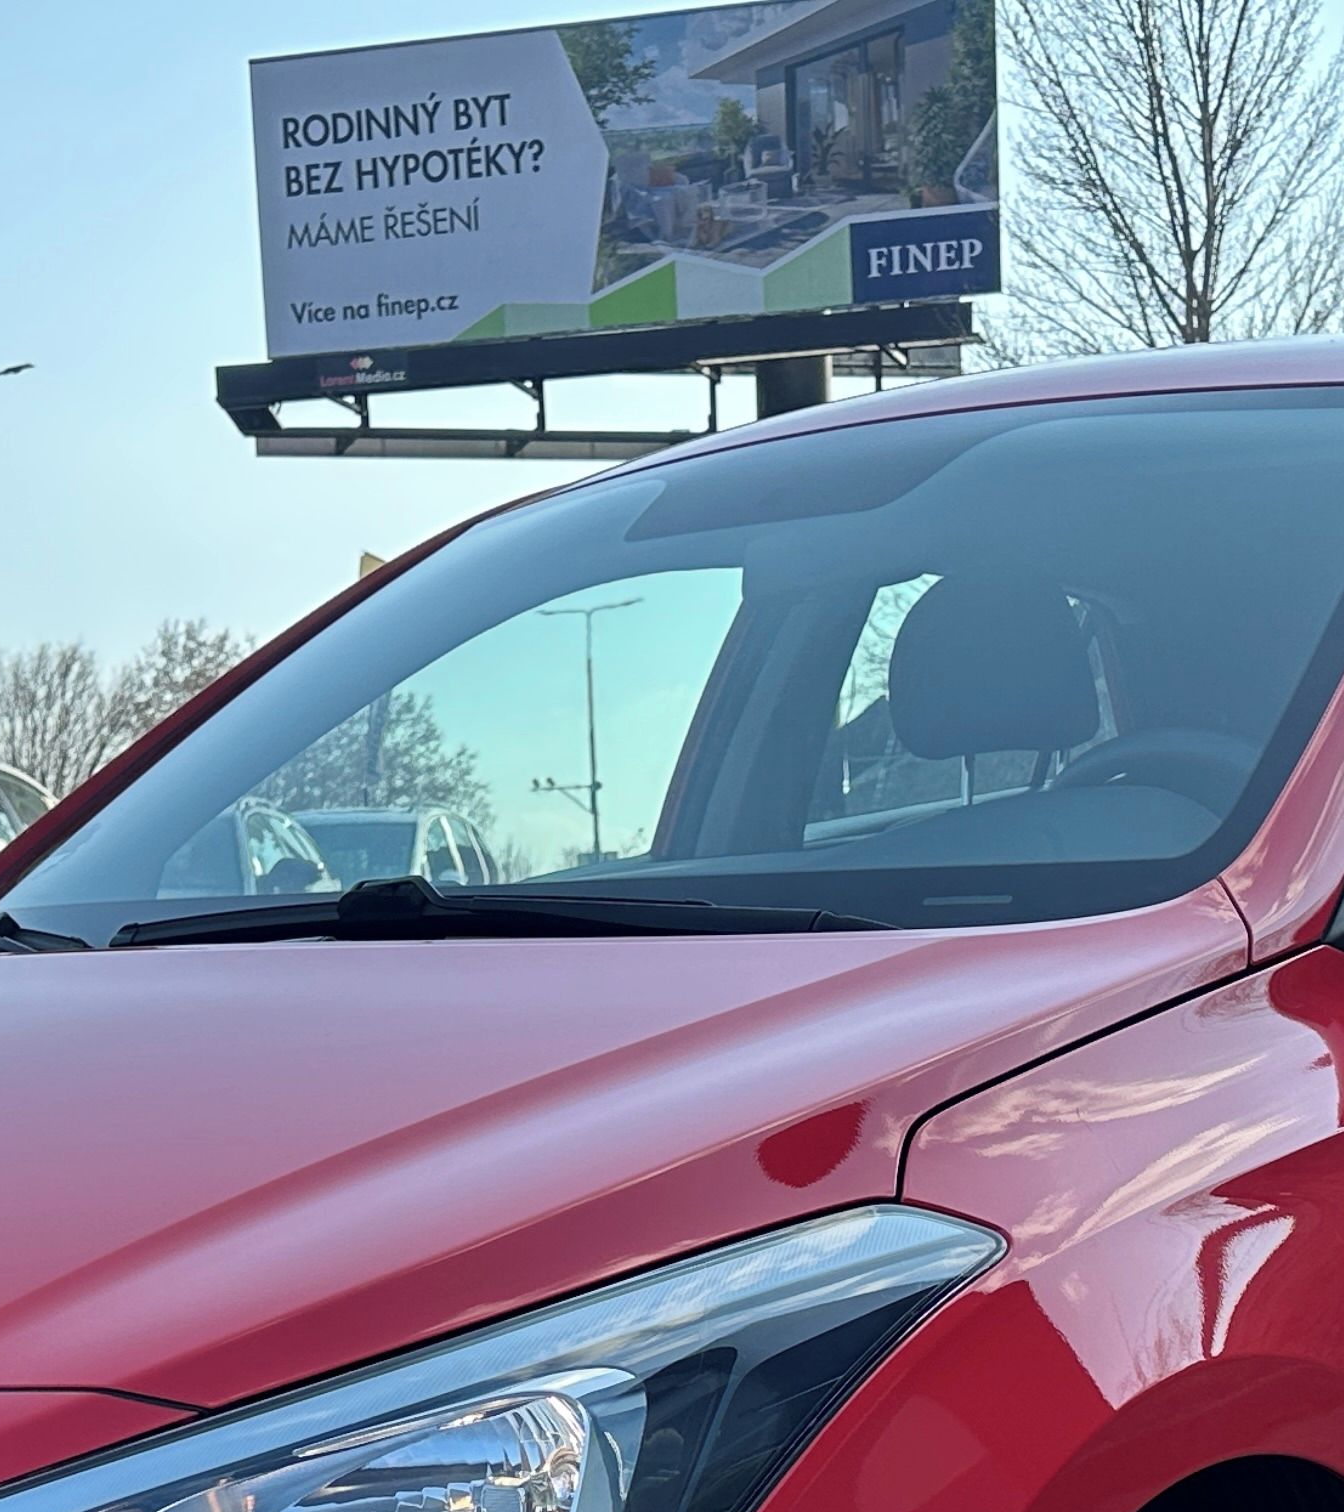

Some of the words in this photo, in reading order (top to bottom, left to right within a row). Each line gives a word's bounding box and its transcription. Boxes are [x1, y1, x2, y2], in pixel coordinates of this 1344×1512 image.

[282, 92, 442, 149] RODINNÝ
[453, 93, 511, 131] BYT
[285, 161, 343, 197] BEZ
[356, 136, 545, 191] HYPOTÉKY?
[287, 213, 374, 249] MÁME
[383, 197, 480, 240] ŘEŠENÍ
[867, 239, 983, 278] FINEP
[290, 302, 336, 324] Více
[342, 303, 370, 320] na
[376, 292, 460, 320] finep.cz
